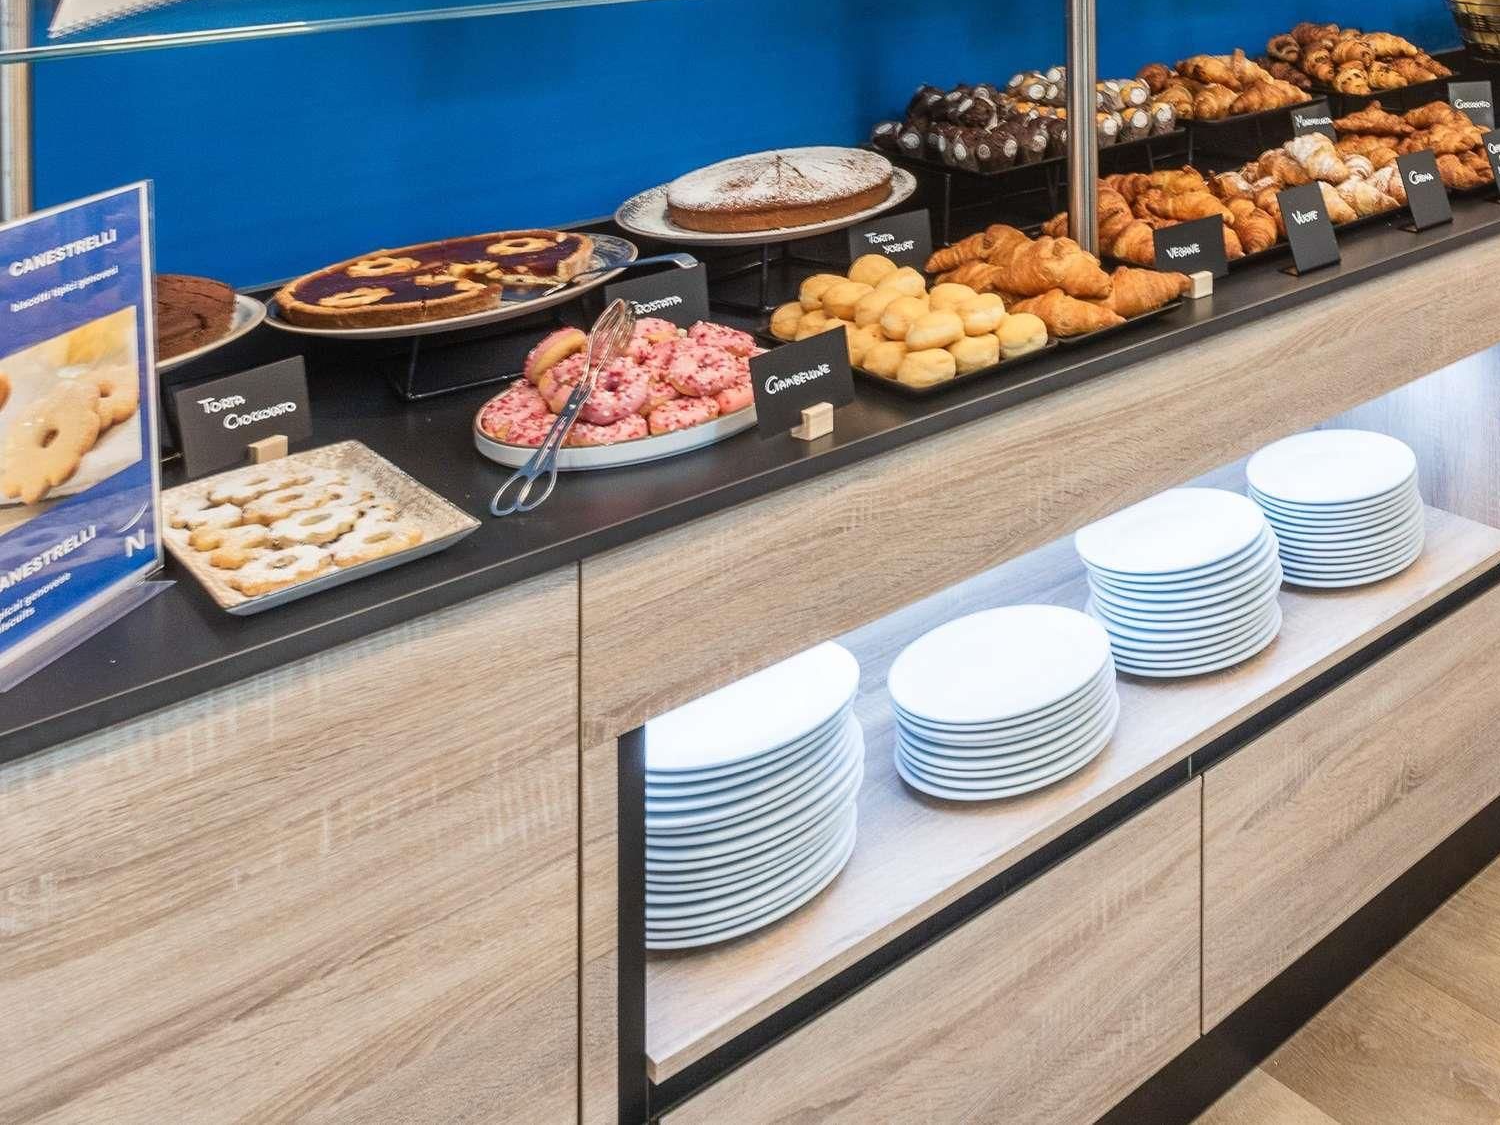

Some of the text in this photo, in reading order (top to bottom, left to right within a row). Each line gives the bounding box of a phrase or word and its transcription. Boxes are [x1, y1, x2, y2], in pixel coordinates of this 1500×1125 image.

[8, 228, 117, 277] CANESTRELLI
[10, 289, 52, 313] biscotti
[124, 528, 146, 558] N
[0, 524, 98, 594] ANESTRELLI
[0, 598, 24, 623] pical
[0, 606, 36, 635] iscuits
